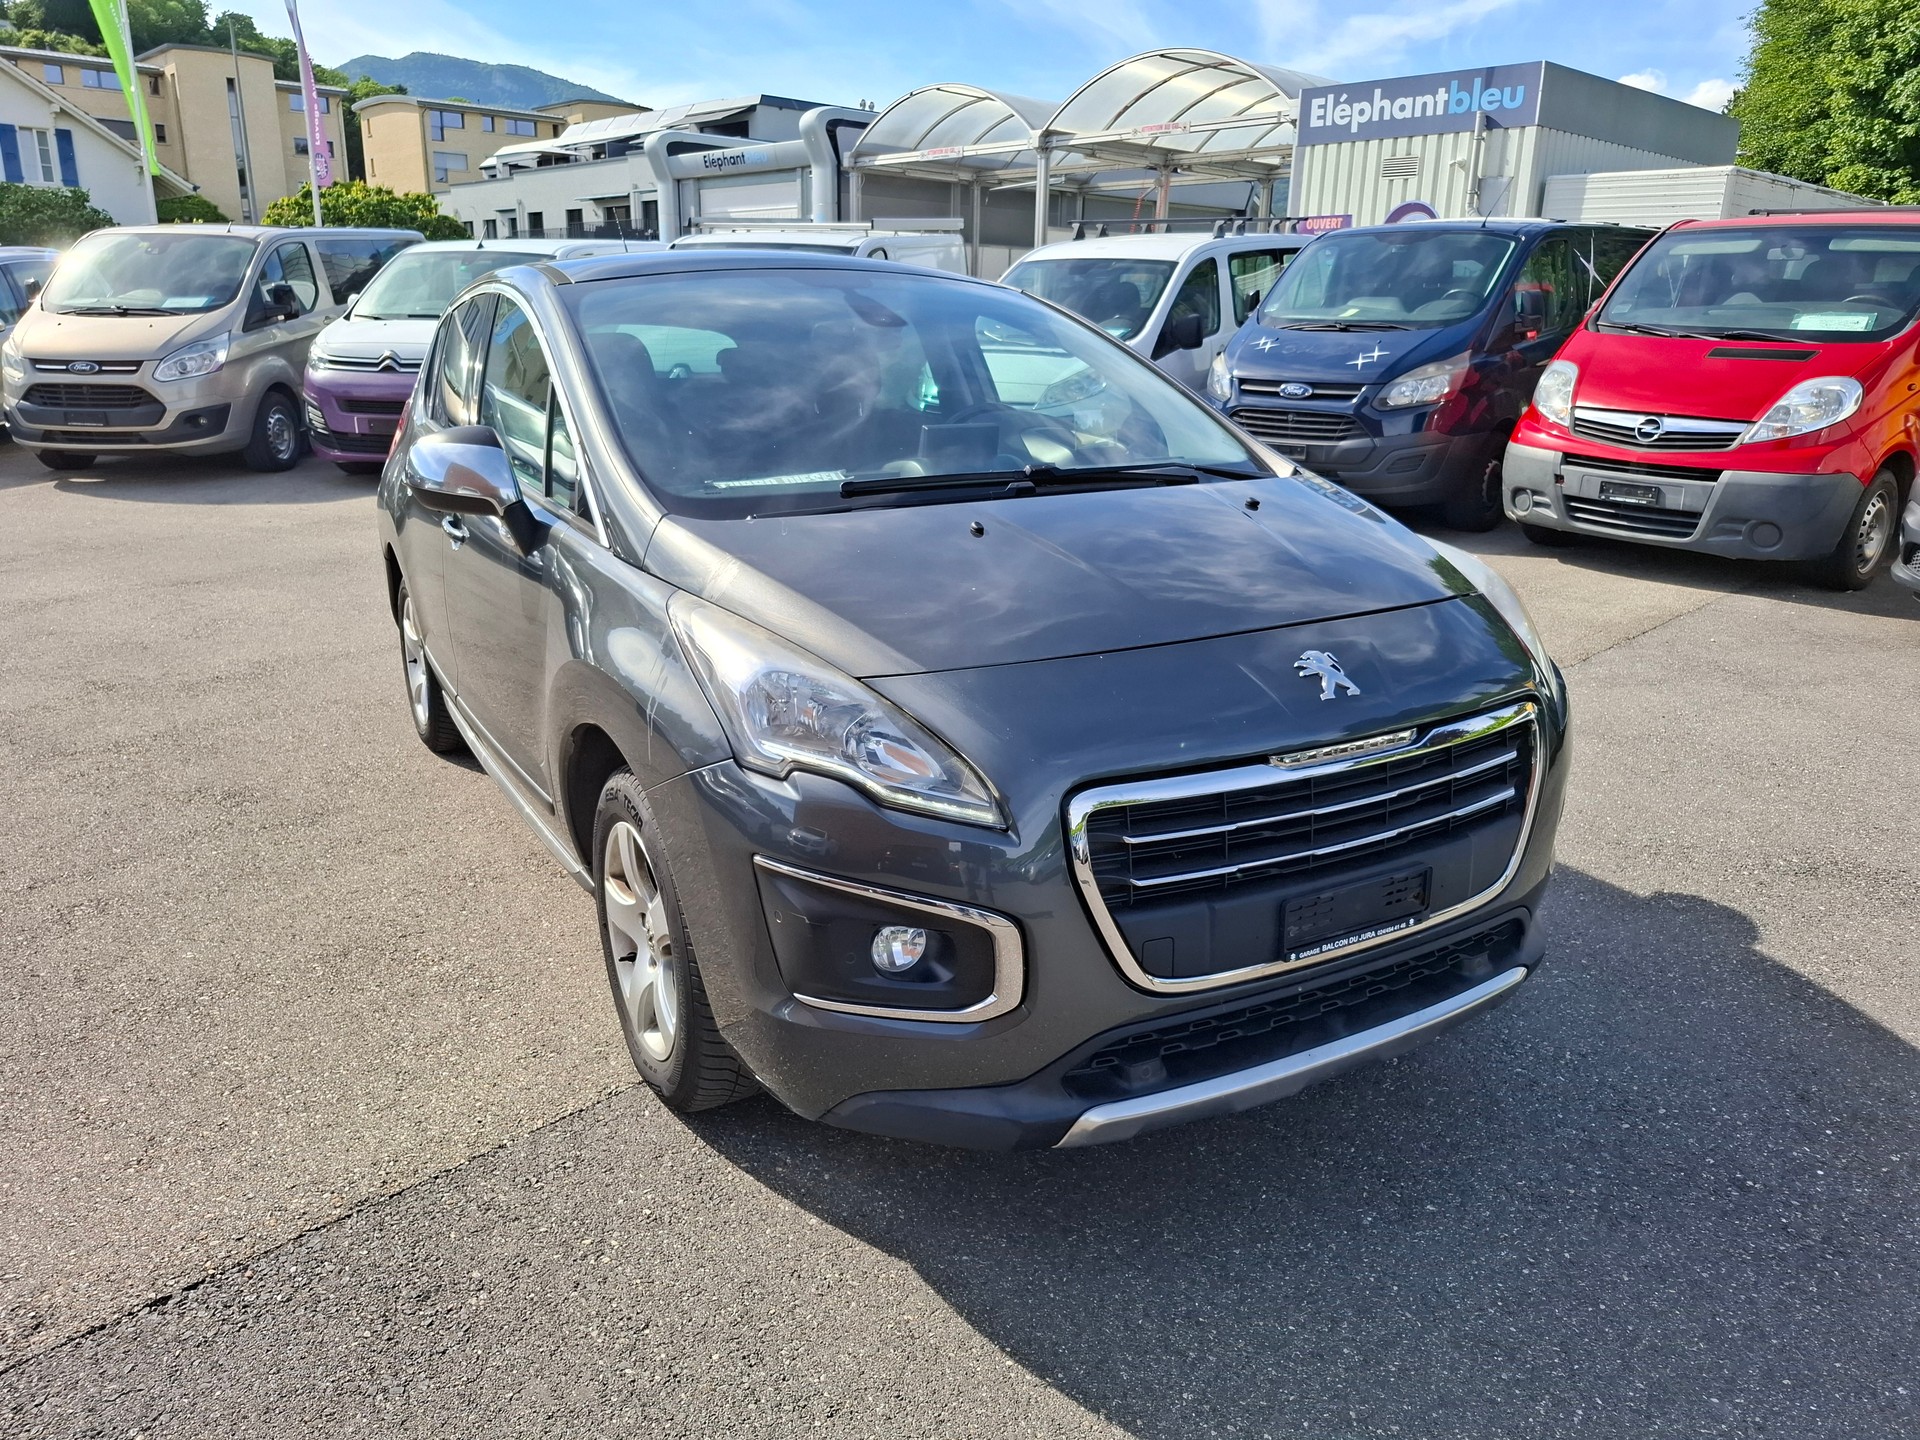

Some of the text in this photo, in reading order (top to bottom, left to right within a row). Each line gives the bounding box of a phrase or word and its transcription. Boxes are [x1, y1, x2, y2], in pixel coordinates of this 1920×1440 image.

[1306, 217, 1343, 230] OUVERT
[73, 363, 91, 371] Ford
[1284, 385, 1305, 396] Ford
[1299, 947, 1320, 958] GARAGE
[1322, 939, 1348, 952] BALCON
[1349, 936, 1358, 944] DU
[1359, 931, 1376, 941] JURA
